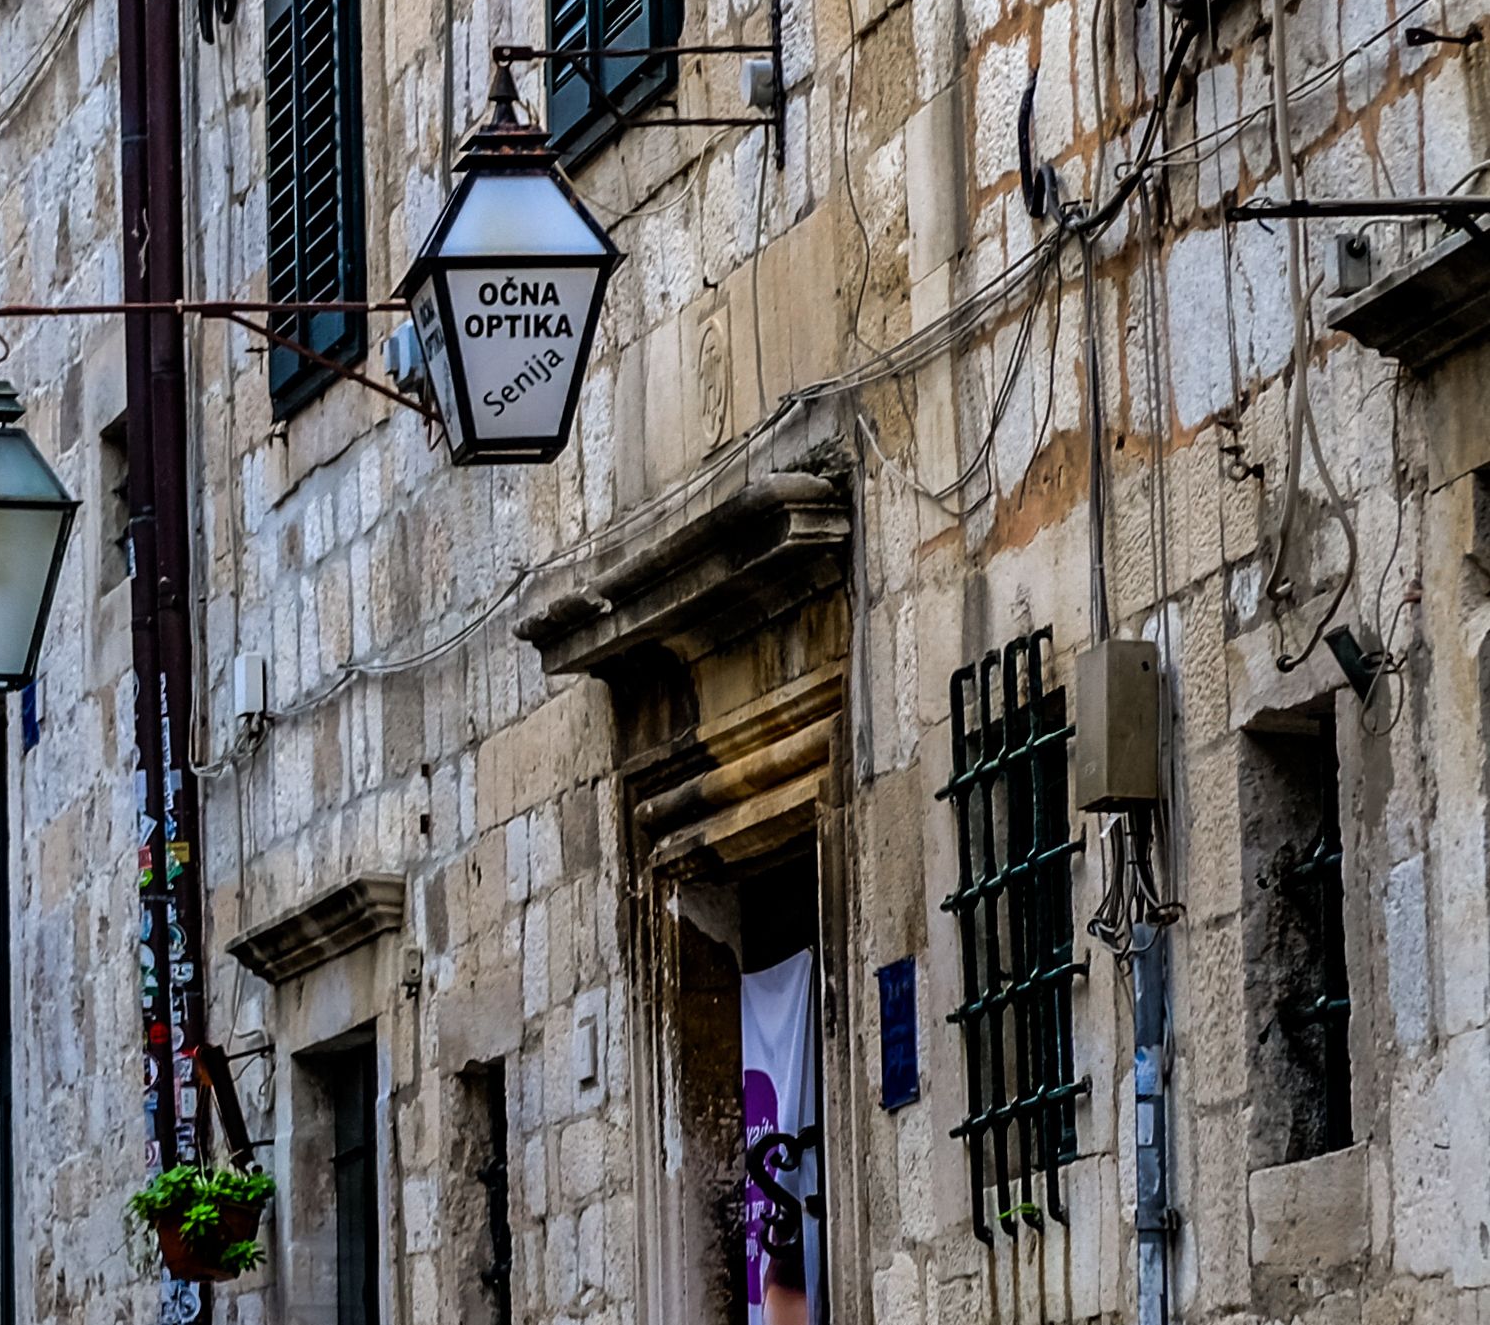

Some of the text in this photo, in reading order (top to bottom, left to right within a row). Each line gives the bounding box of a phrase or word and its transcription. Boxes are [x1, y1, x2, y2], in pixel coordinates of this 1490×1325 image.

[477, 276, 561, 307] OČNA
[464, 313, 575, 339] OPTIKA
[482, 345, 565, 419] Senija
